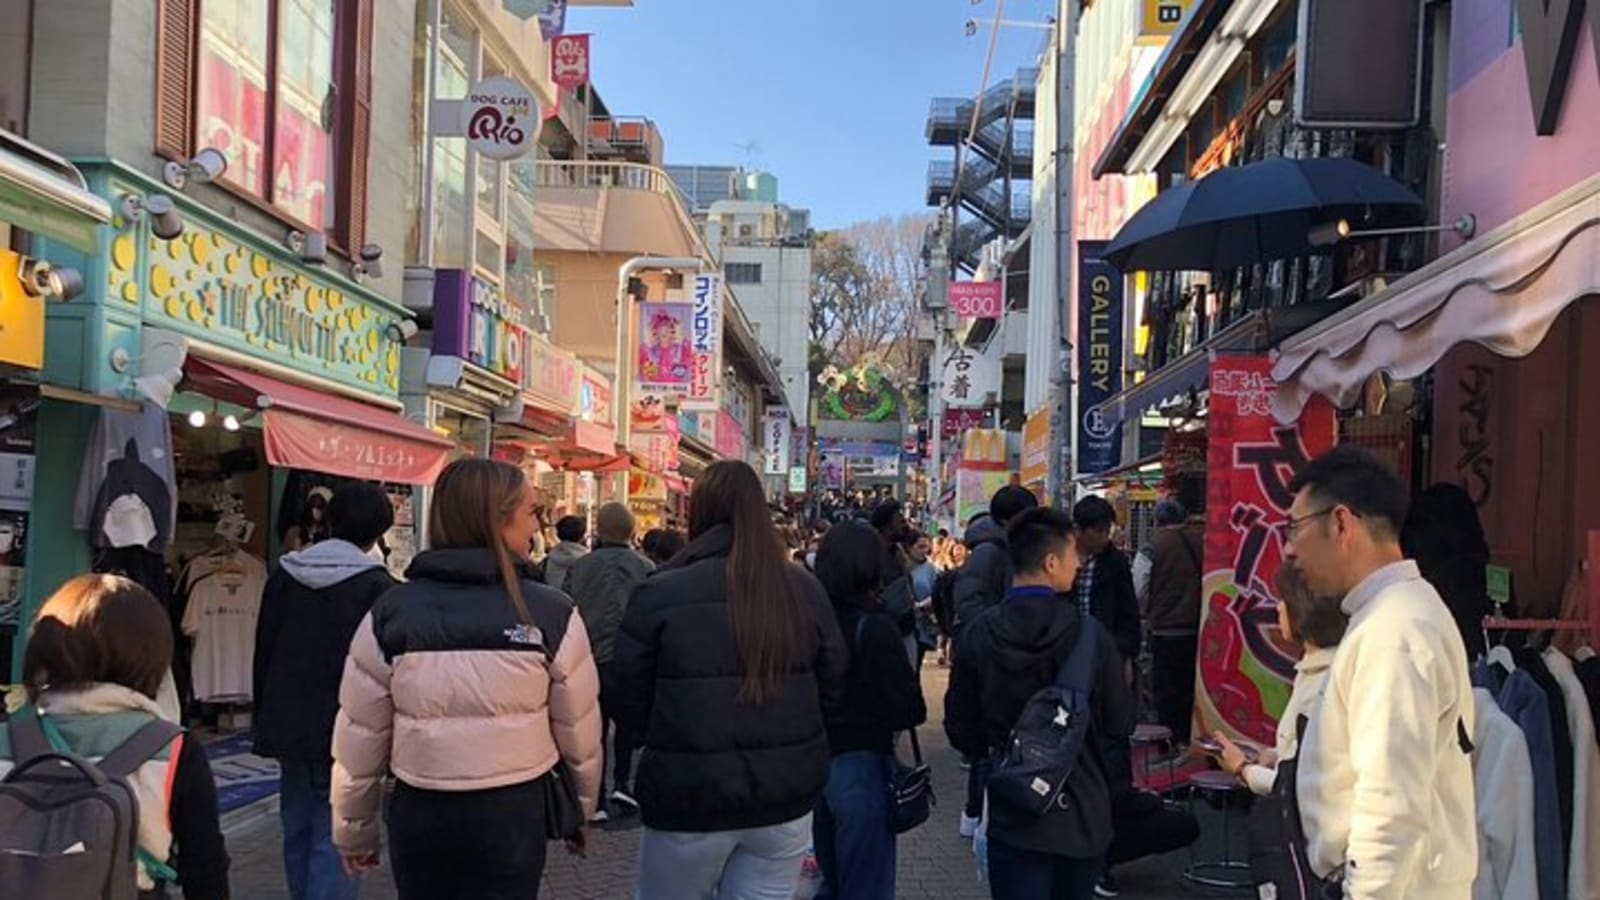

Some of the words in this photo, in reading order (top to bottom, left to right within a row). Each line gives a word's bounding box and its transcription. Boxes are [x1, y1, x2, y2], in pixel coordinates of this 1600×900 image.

[471, 95, 496, 104] DOG
[501, 97, 528, 107] CAFE
[468, 106, 524, 145] Rio
[959, 297, 994, 315] 300
[1090, 275, 1111, 392] GALLERY
[943, 349, 974, 399] 古着
